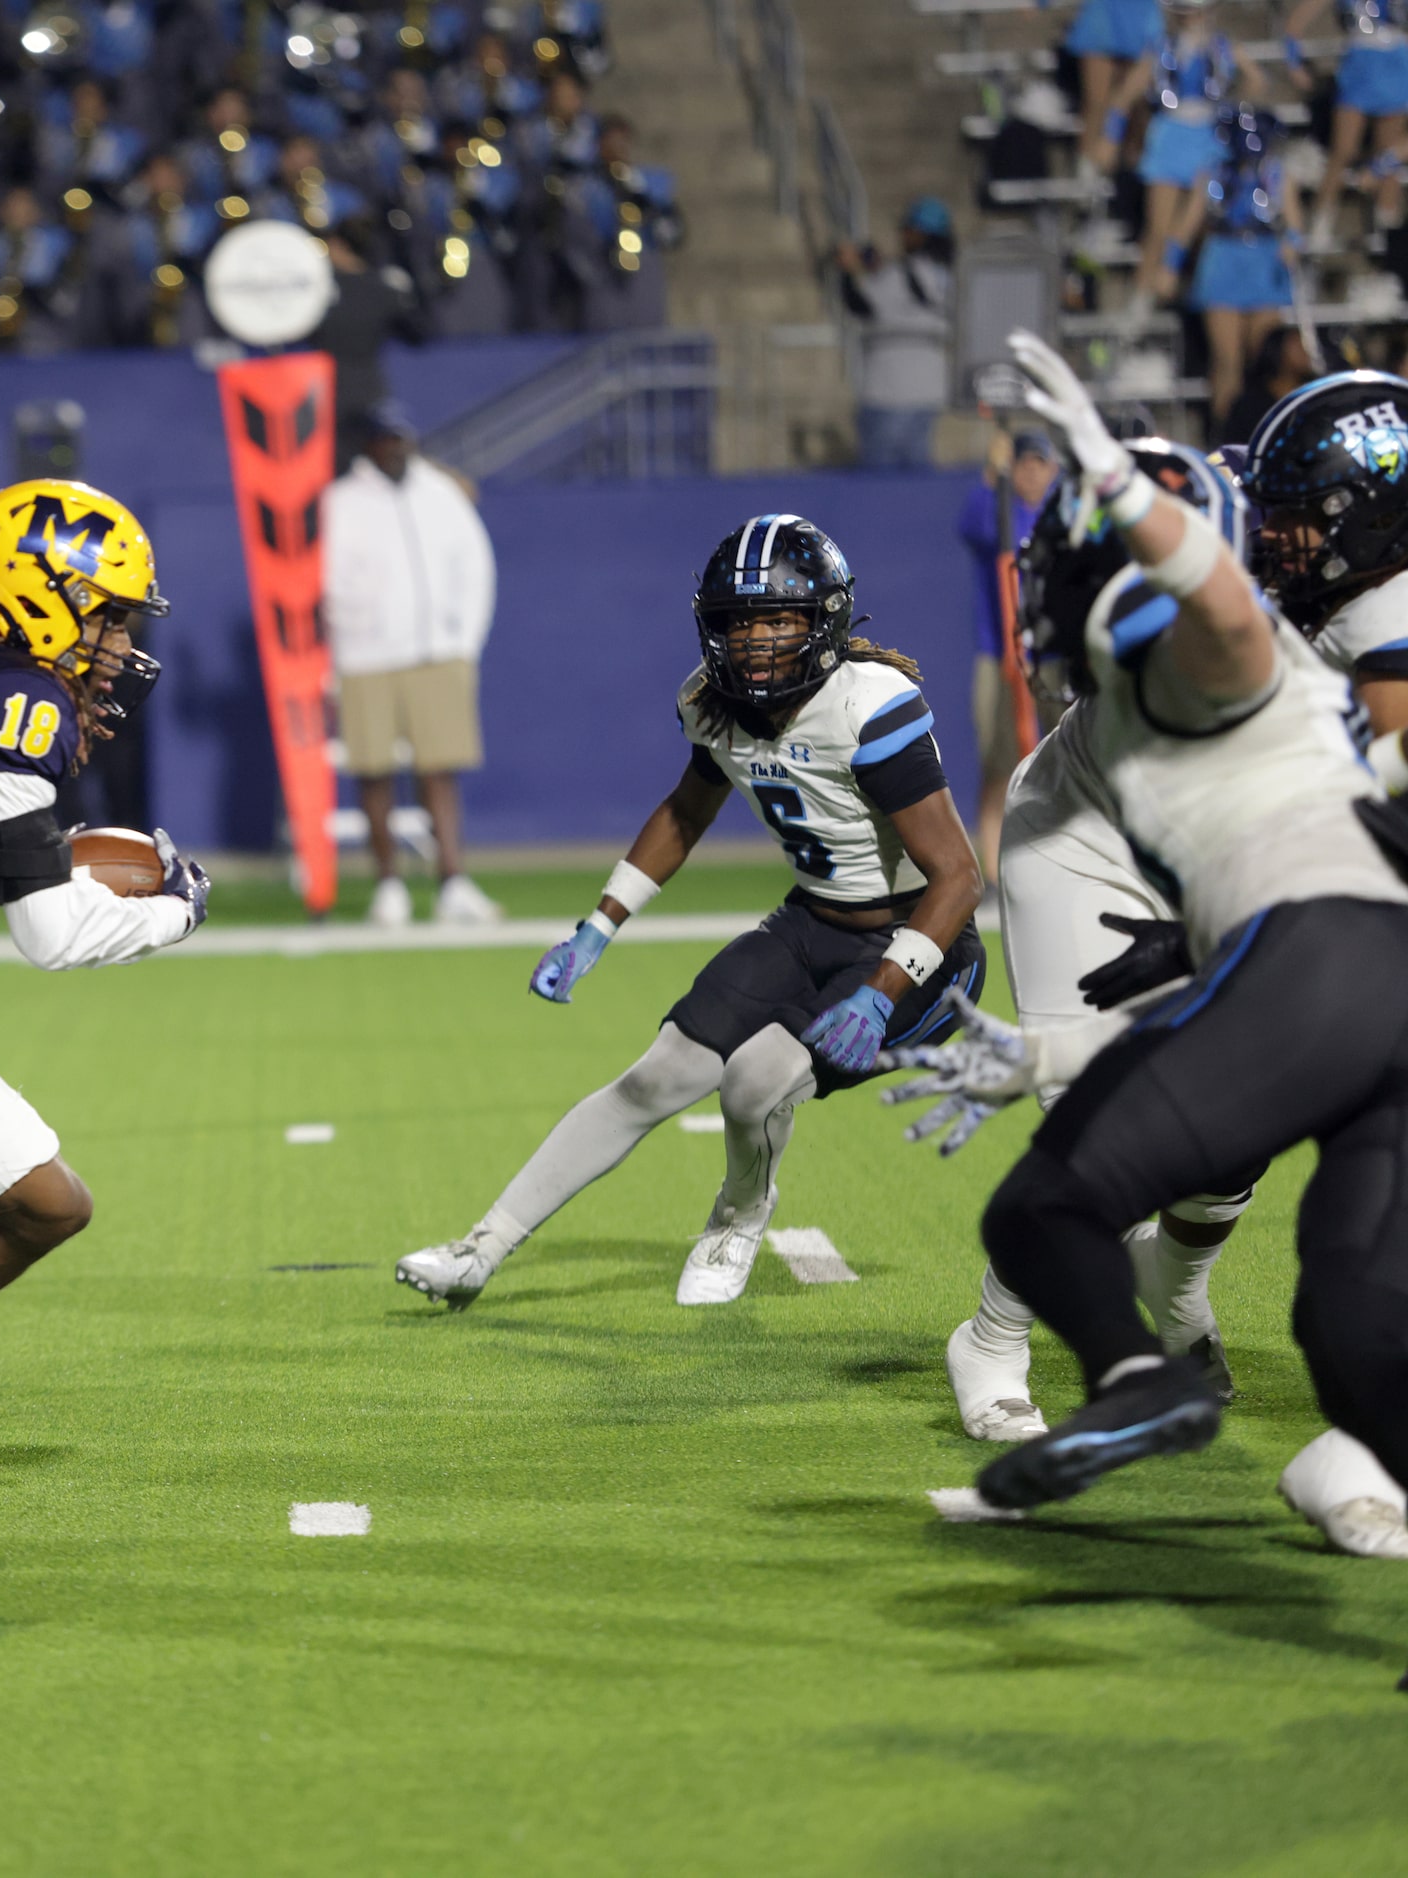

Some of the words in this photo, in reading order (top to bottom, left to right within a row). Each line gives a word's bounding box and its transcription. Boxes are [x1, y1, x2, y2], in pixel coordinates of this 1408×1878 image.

[1334, 401, 1408, 453] RH
[16, 494, 116, 578] M
[750, 762, 769, 777] The
